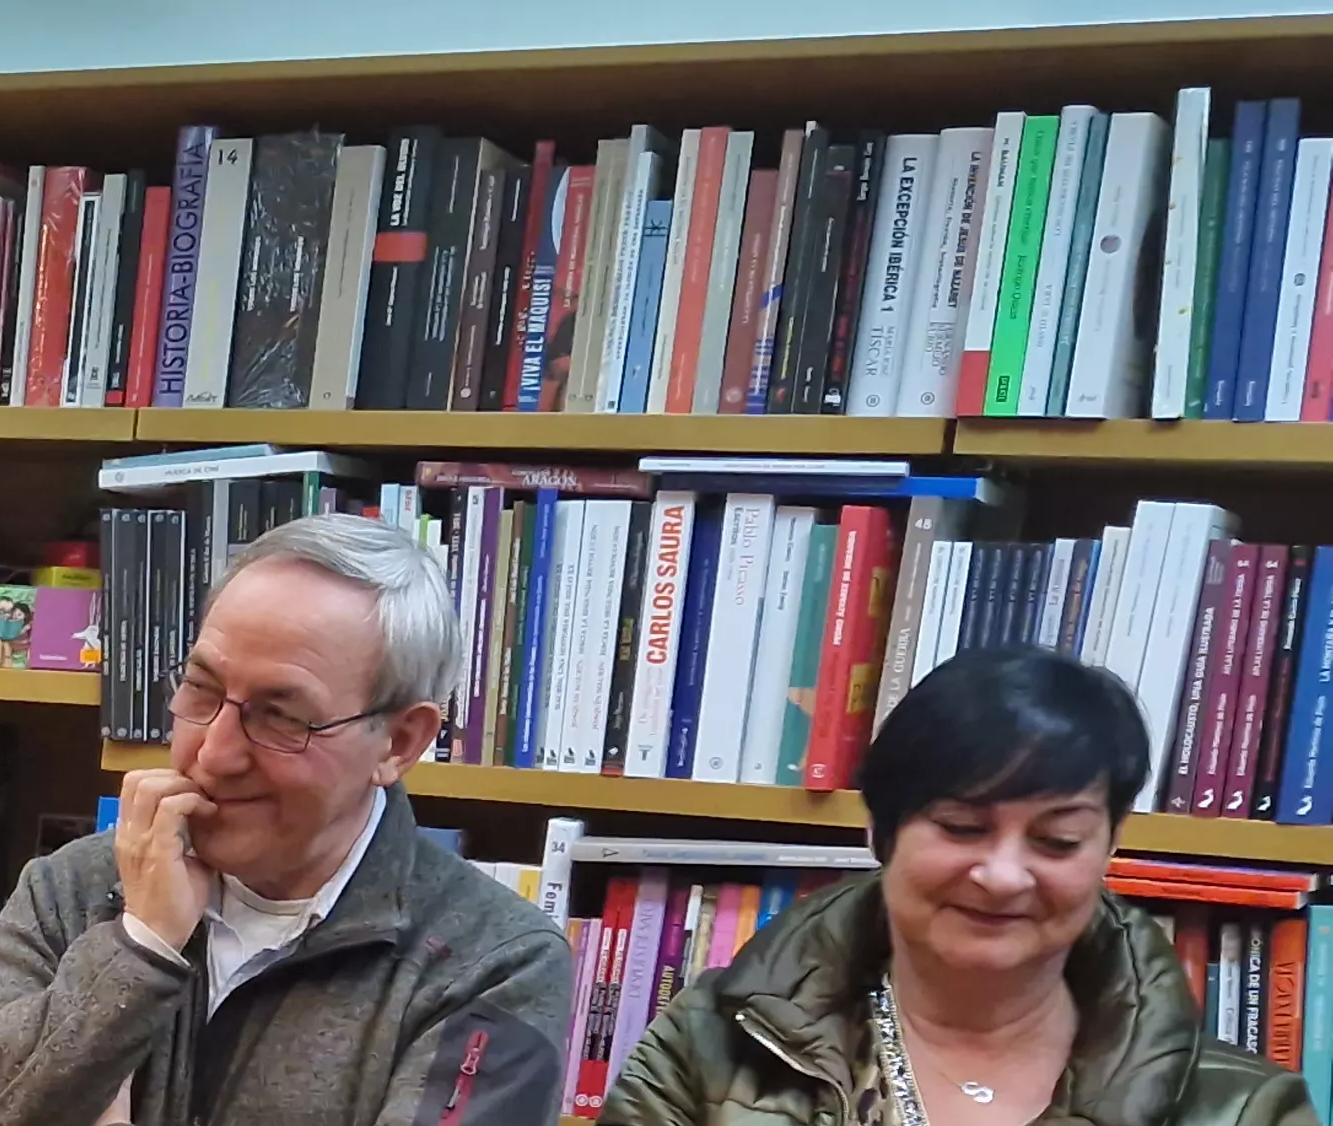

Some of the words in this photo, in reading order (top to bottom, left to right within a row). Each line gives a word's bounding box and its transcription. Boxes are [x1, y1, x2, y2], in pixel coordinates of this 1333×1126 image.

[218, 149, 238, 166] 14
[901, 157, 918, 173] LA
[970, 151, 982, 163] LA
[891, 177, 915, 248] EXCEPCIÓN
[961, 212, 972, 224] DE
[159, 142, 205, 394] HISTORIA-BIOGRAFÍA
[882, 252, 903, 301] IBÉRICA
[527, 278, 552, 333] MAQUIS!
[524, 336, 544, 353] EL
[864, 326, 885, 377] TÍSCAR
[520, 356, 542, 391] ¡VIVA
[656, 505, 684, 578] SAURA
[742, 508, 761, 549] Pablo
[735, 554, 755, 606] Picasso
[1232, 598, 1243, 608] LA
[1261, 599, 1273, 609] LA
[646, 581, 675, 665] CARLOS
[893, 627, 911, 673] GUERRA
[889, 677, 902, 690] LA
[1177, 764, 1189, 775] EL
[1190, 679, 1204, 700] UNA
[1197, 607, 1214, 655] ILUSTRADA
[550, 840, 566, 855] 34
[1247, 989, 1260, 1005] UN
[1248, 973, 1261, 989] DE
